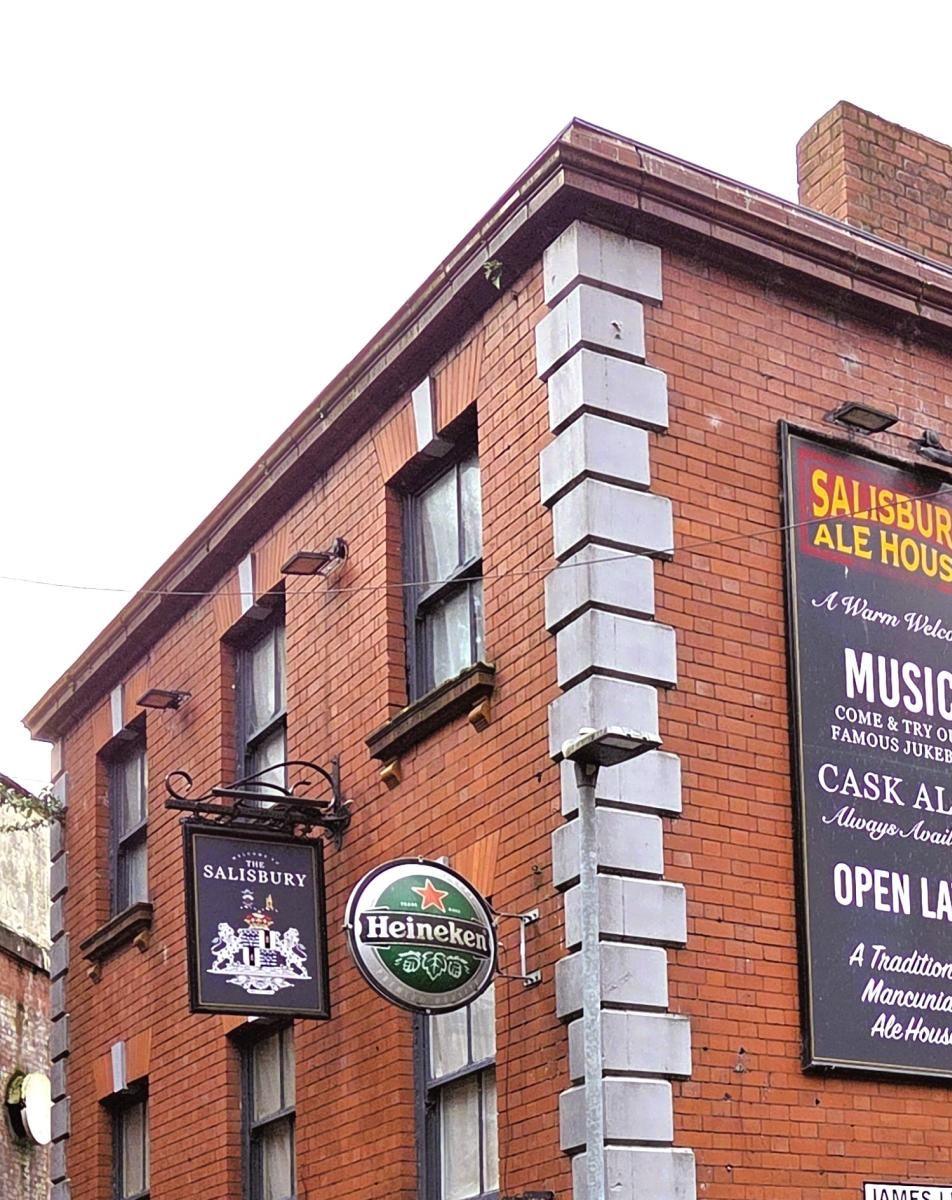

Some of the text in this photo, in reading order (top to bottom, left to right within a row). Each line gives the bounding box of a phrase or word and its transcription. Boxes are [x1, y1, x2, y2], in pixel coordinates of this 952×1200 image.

[813, 524, 872, 560] ALE
[811, 591, 839, 611] A
[841, 596, 900, 627] Warm
[831, 725, 900, 753] FAMOUS
[835, 705, 883, 729] COME
[887, 716, 899, 732] &
[902, 719, 933, 739] TRY
[818, 763, 906, 807] CASK
[822, 806, 899, 841] Always
[203, 864, 307, 888] SALISBURY
[246, 860, 265, 869] THE
[833, 862, 911, 915] OPEN
[365, 915, 489, 952] Heineken
[849, 942, 865, 968] A
[870, 1013, 905, 1041] Ale
